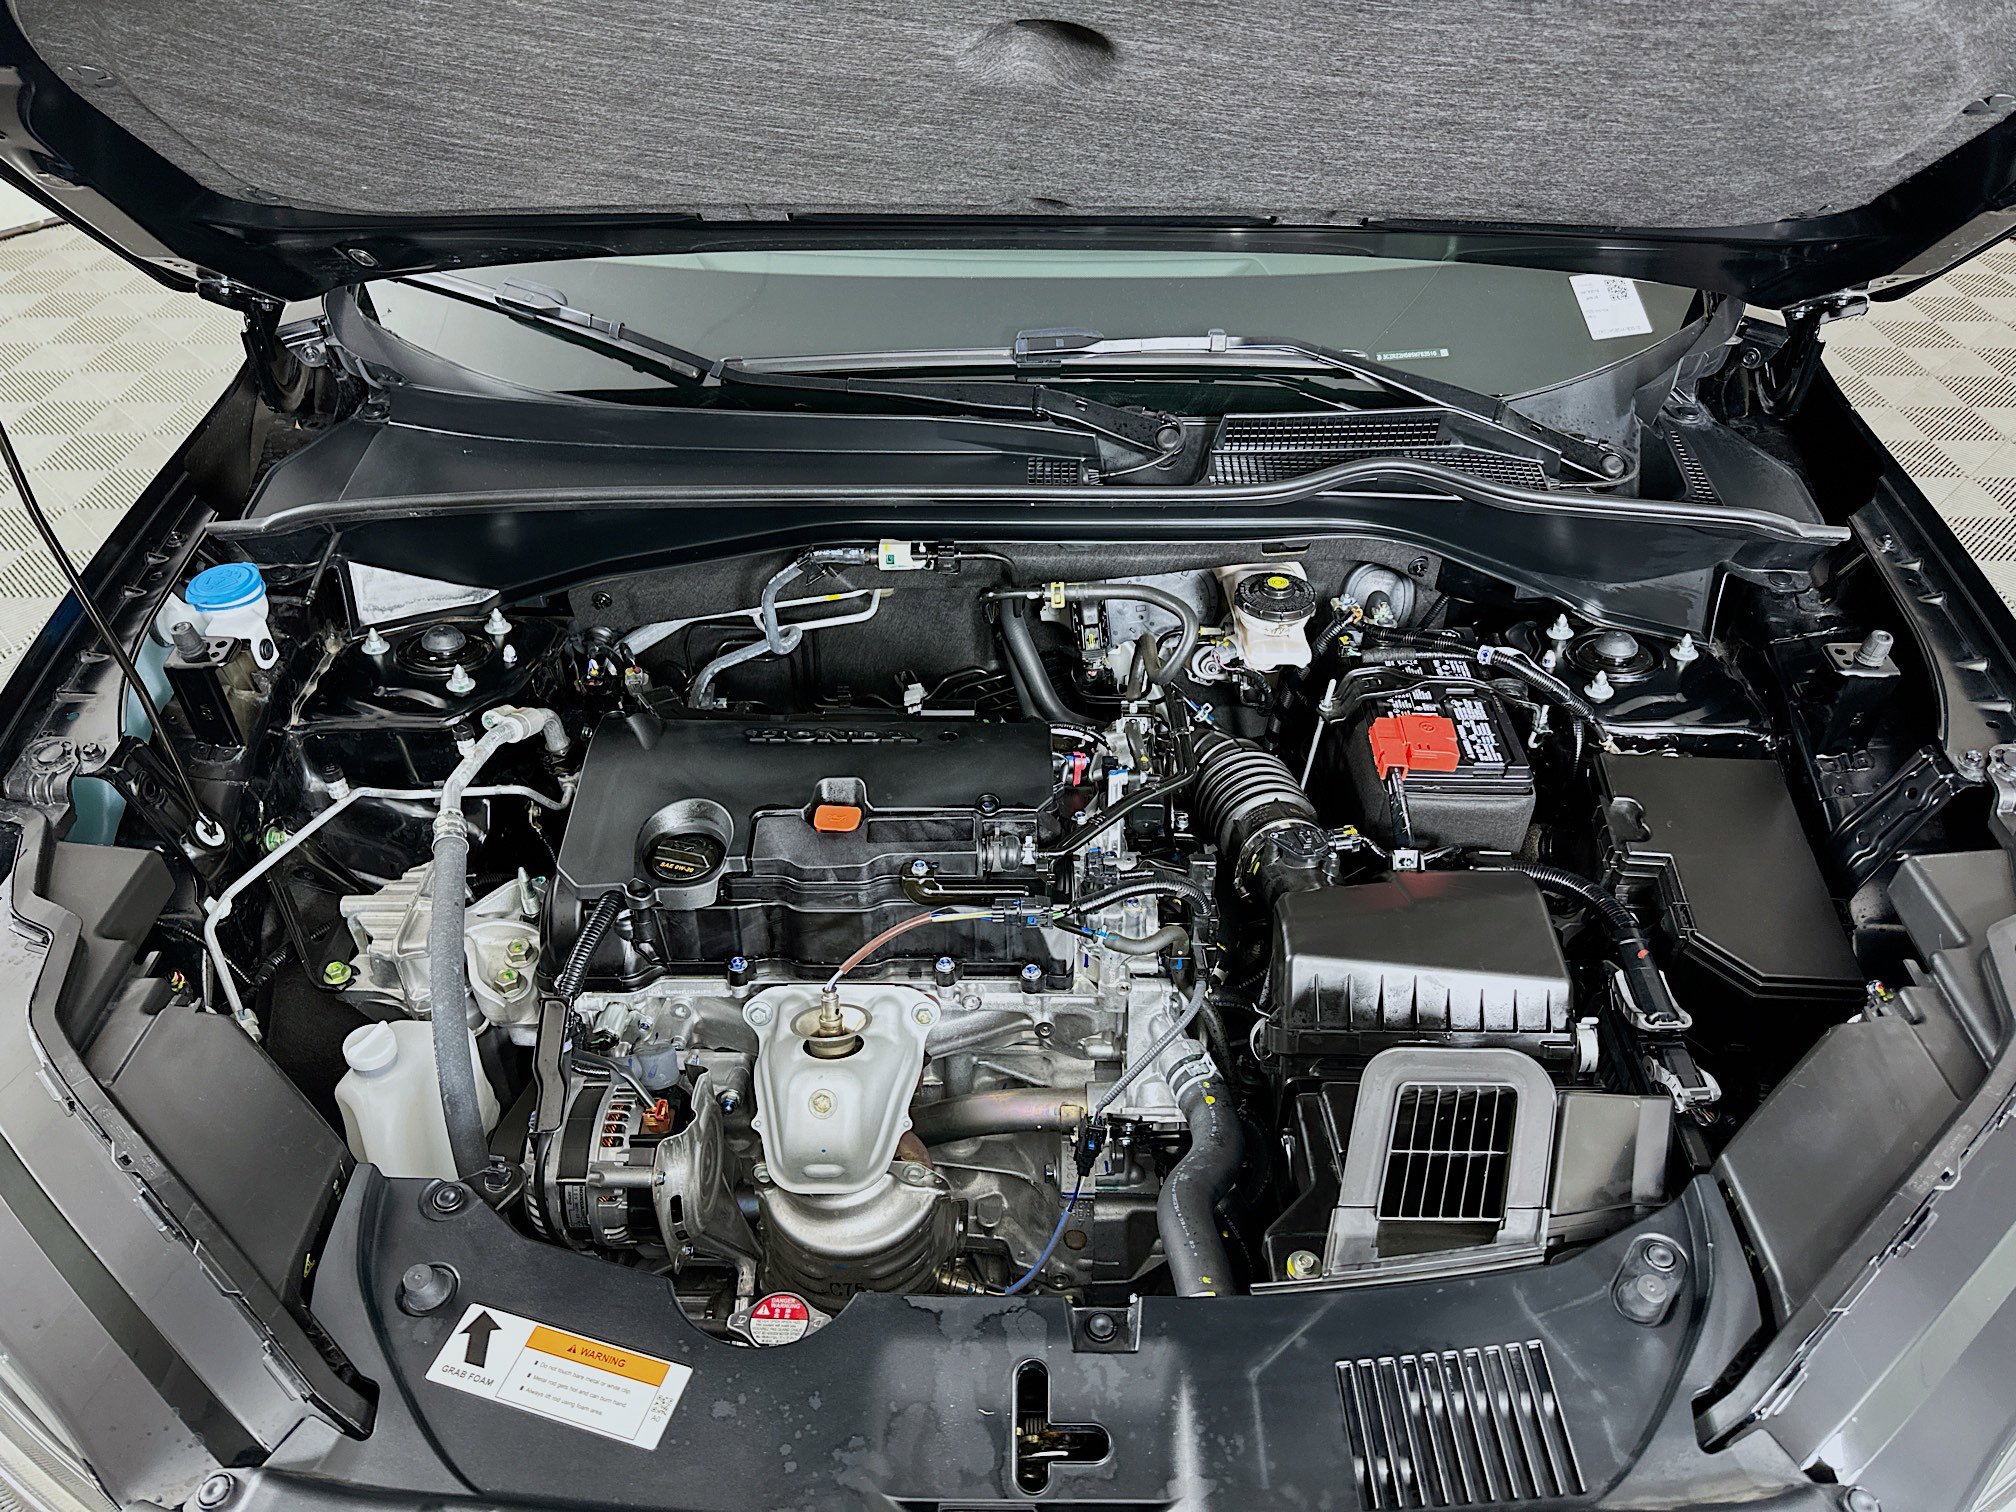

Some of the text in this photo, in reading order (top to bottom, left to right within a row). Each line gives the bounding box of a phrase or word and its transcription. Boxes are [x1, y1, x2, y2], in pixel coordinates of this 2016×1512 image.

[745, 727, 920, 744] HONDA
[660, 861, 675, 869] SAE
[580, 1347, 626, 1368] WARNING
[441, 1364, 495, 1387] GRAB FOAM
[540, 1361, 548, 1369] Do
[558, 1367, 573, 1376] touch
[585, 1376, 600, 1384] metal
[526, 1387, 544, 1398] Always
[533, 1374, 547, 1383] Metal
[579, 1389, 589, 1397] and
